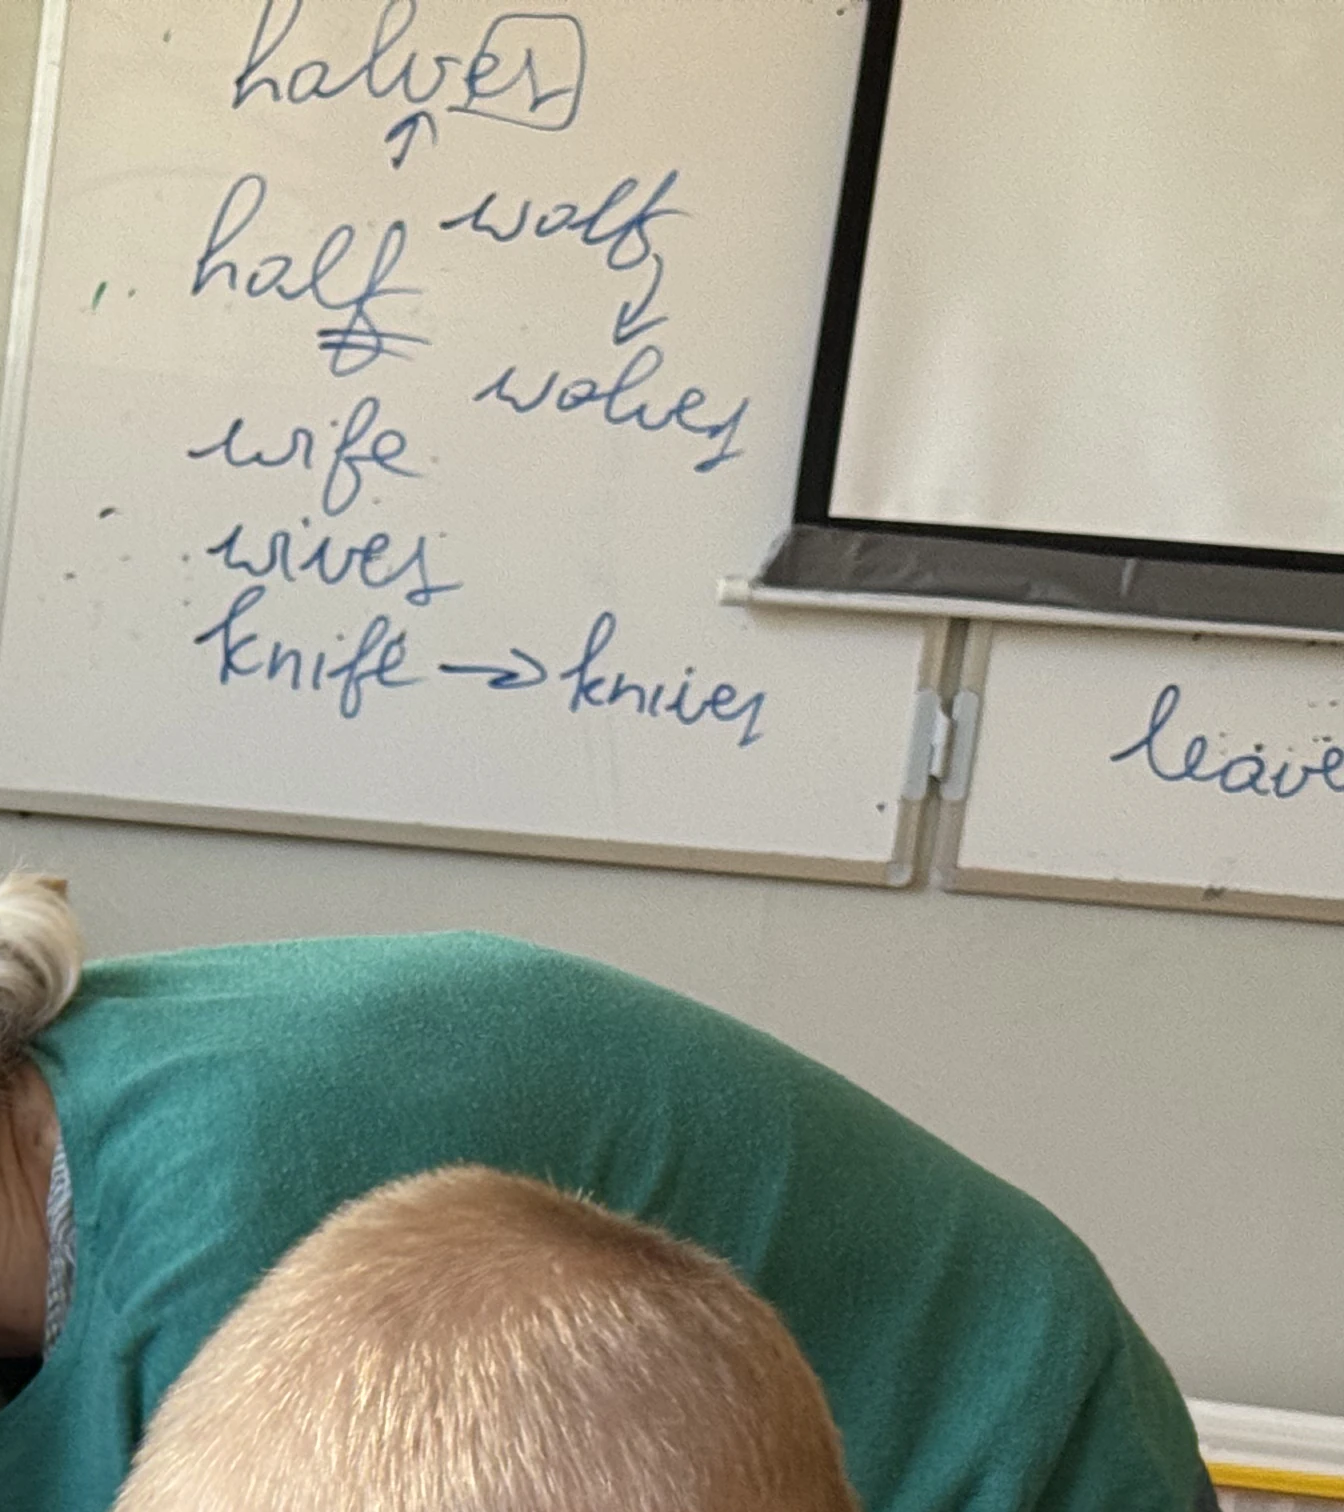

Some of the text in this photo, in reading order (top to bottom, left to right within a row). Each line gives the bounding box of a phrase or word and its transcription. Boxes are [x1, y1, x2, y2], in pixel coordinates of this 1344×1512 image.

[232, 0, 576, 112] halves
[192, 175, 422, 376] half
[440, 170, 690, 270] wolf
[188, 398, 424, 515] wife
[474, 345, 750, 474] wolves
[207, 517, 464, 606] wives
[193, 585, 767, 748] knife knives
